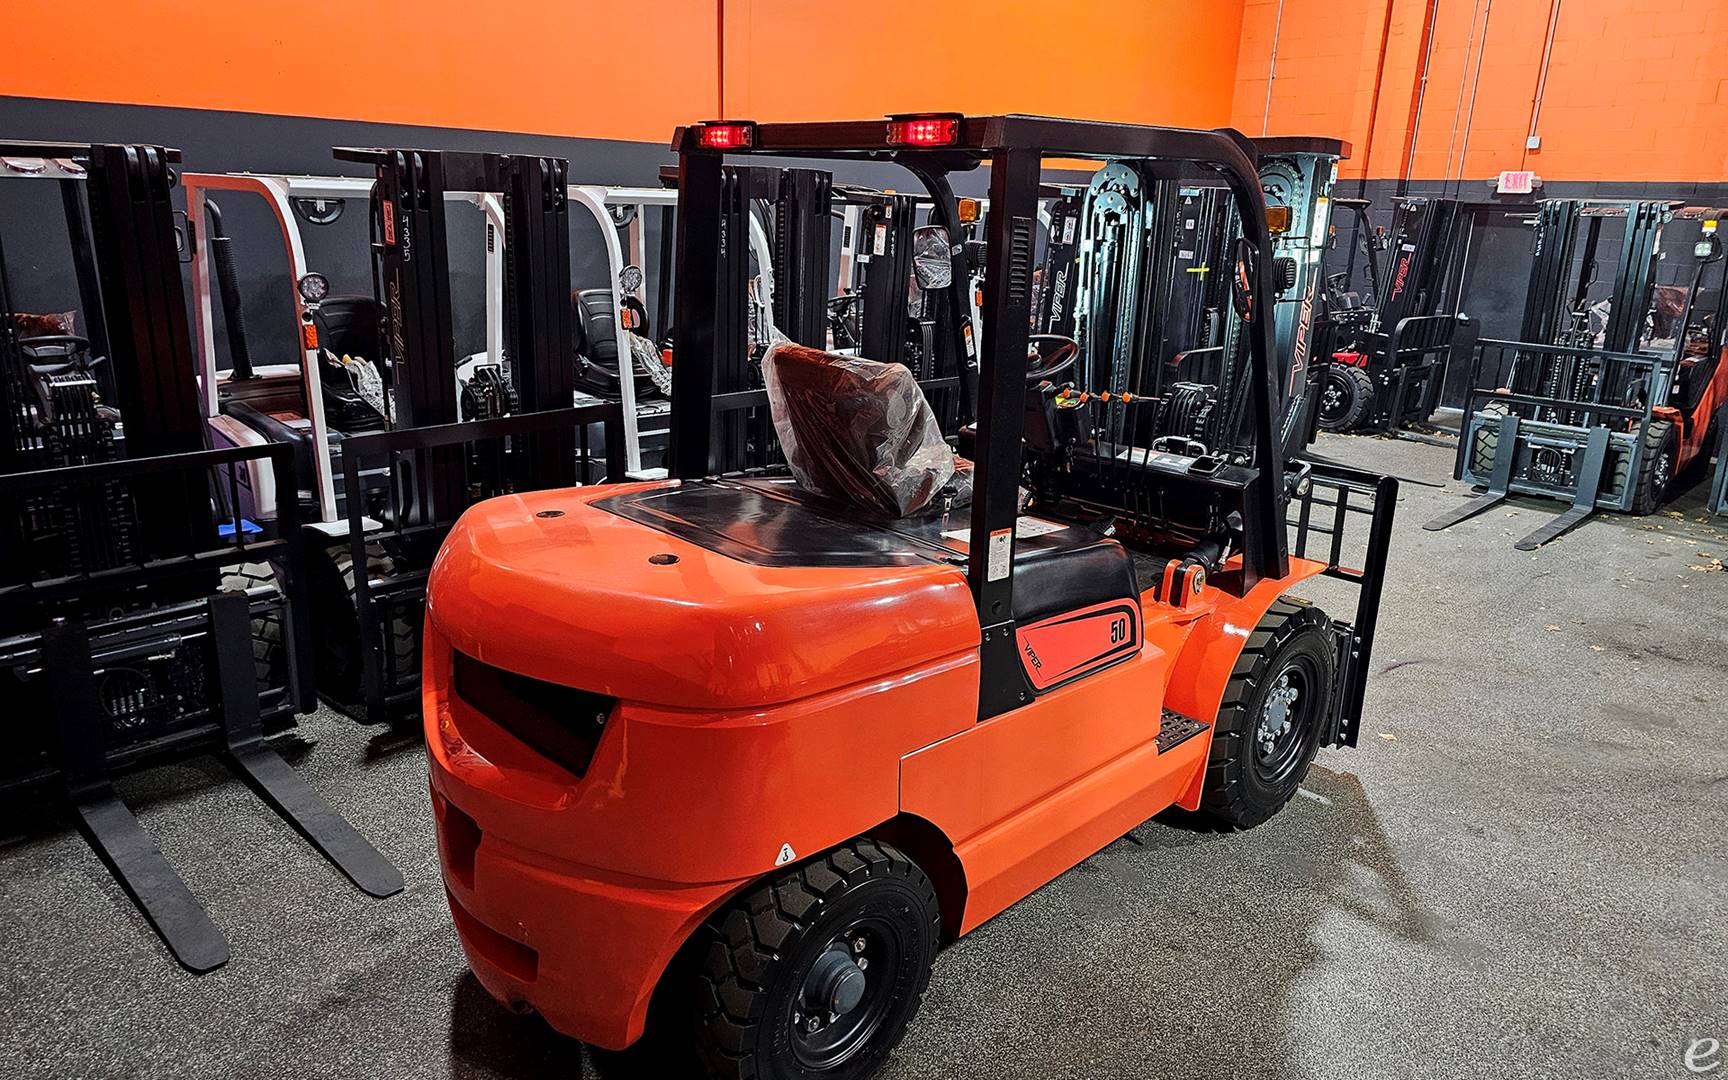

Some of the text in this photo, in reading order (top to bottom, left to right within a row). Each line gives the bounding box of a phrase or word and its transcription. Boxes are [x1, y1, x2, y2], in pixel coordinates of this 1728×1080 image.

[1504, 172, 1529, 191] EXIT
[402, 215, 411, 262] 4335
[1048, 262, 1069, 334] VIPER
[1391, 253, 1412, 301] VIPER
[389, 269, 405, 383] VIPER
[1290, 269, 1318, 395] VIPER
[1110, 617, 1126, 644] 50
[1023, 637, 1042, 674] VIPER
